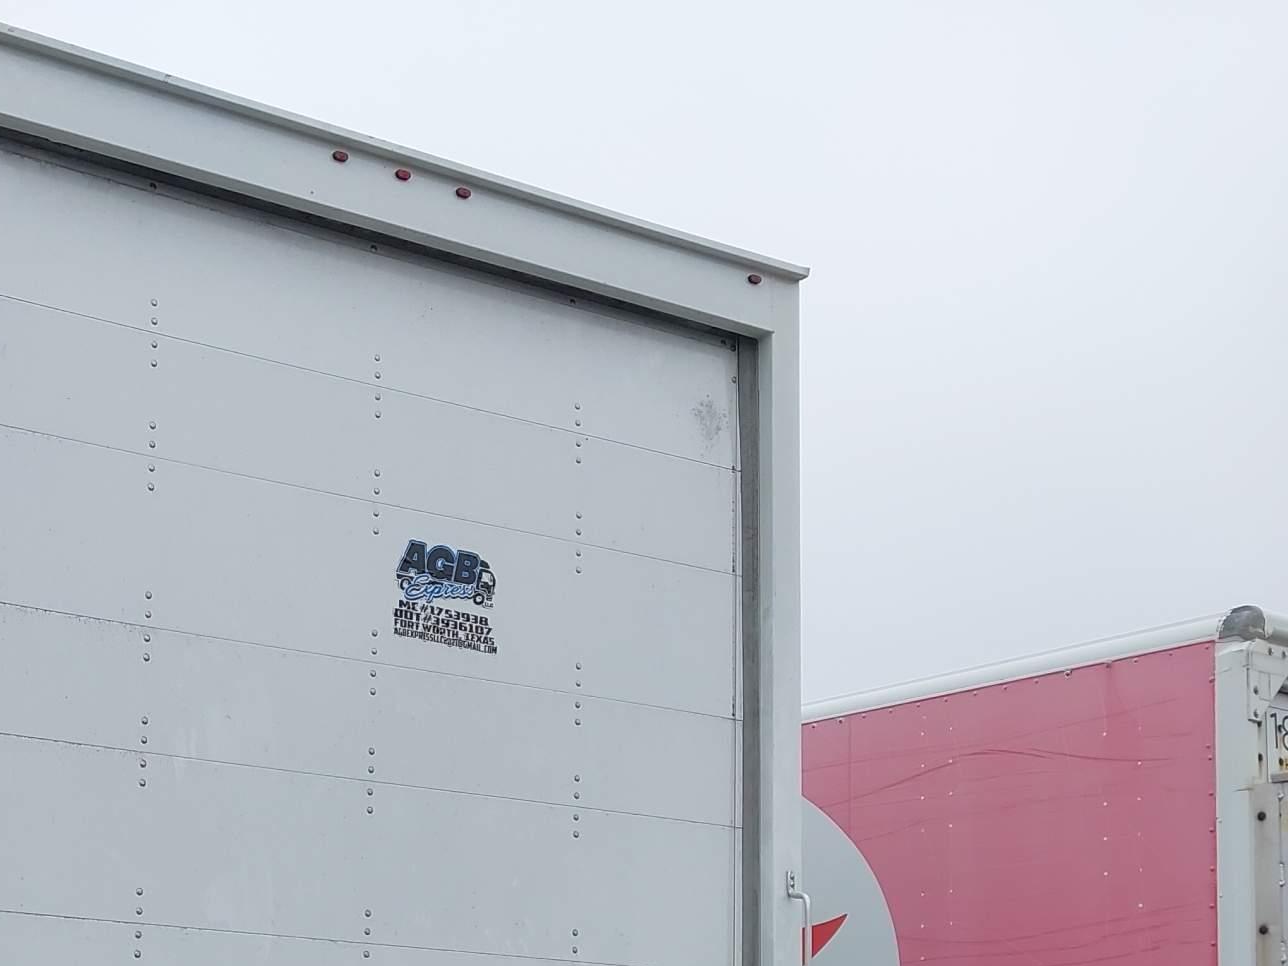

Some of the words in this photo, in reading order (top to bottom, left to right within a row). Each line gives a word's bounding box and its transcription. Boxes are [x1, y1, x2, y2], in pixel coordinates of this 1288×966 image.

[396, 539, 481, 584] AGB
[404, 574, 475, 603] Express
[393, 608, 421, 622] DOT
[398, 599, 419, 612] MC
[394, 618, 420, 631] FORT
[464, 633, 495, 646] TEXAS
